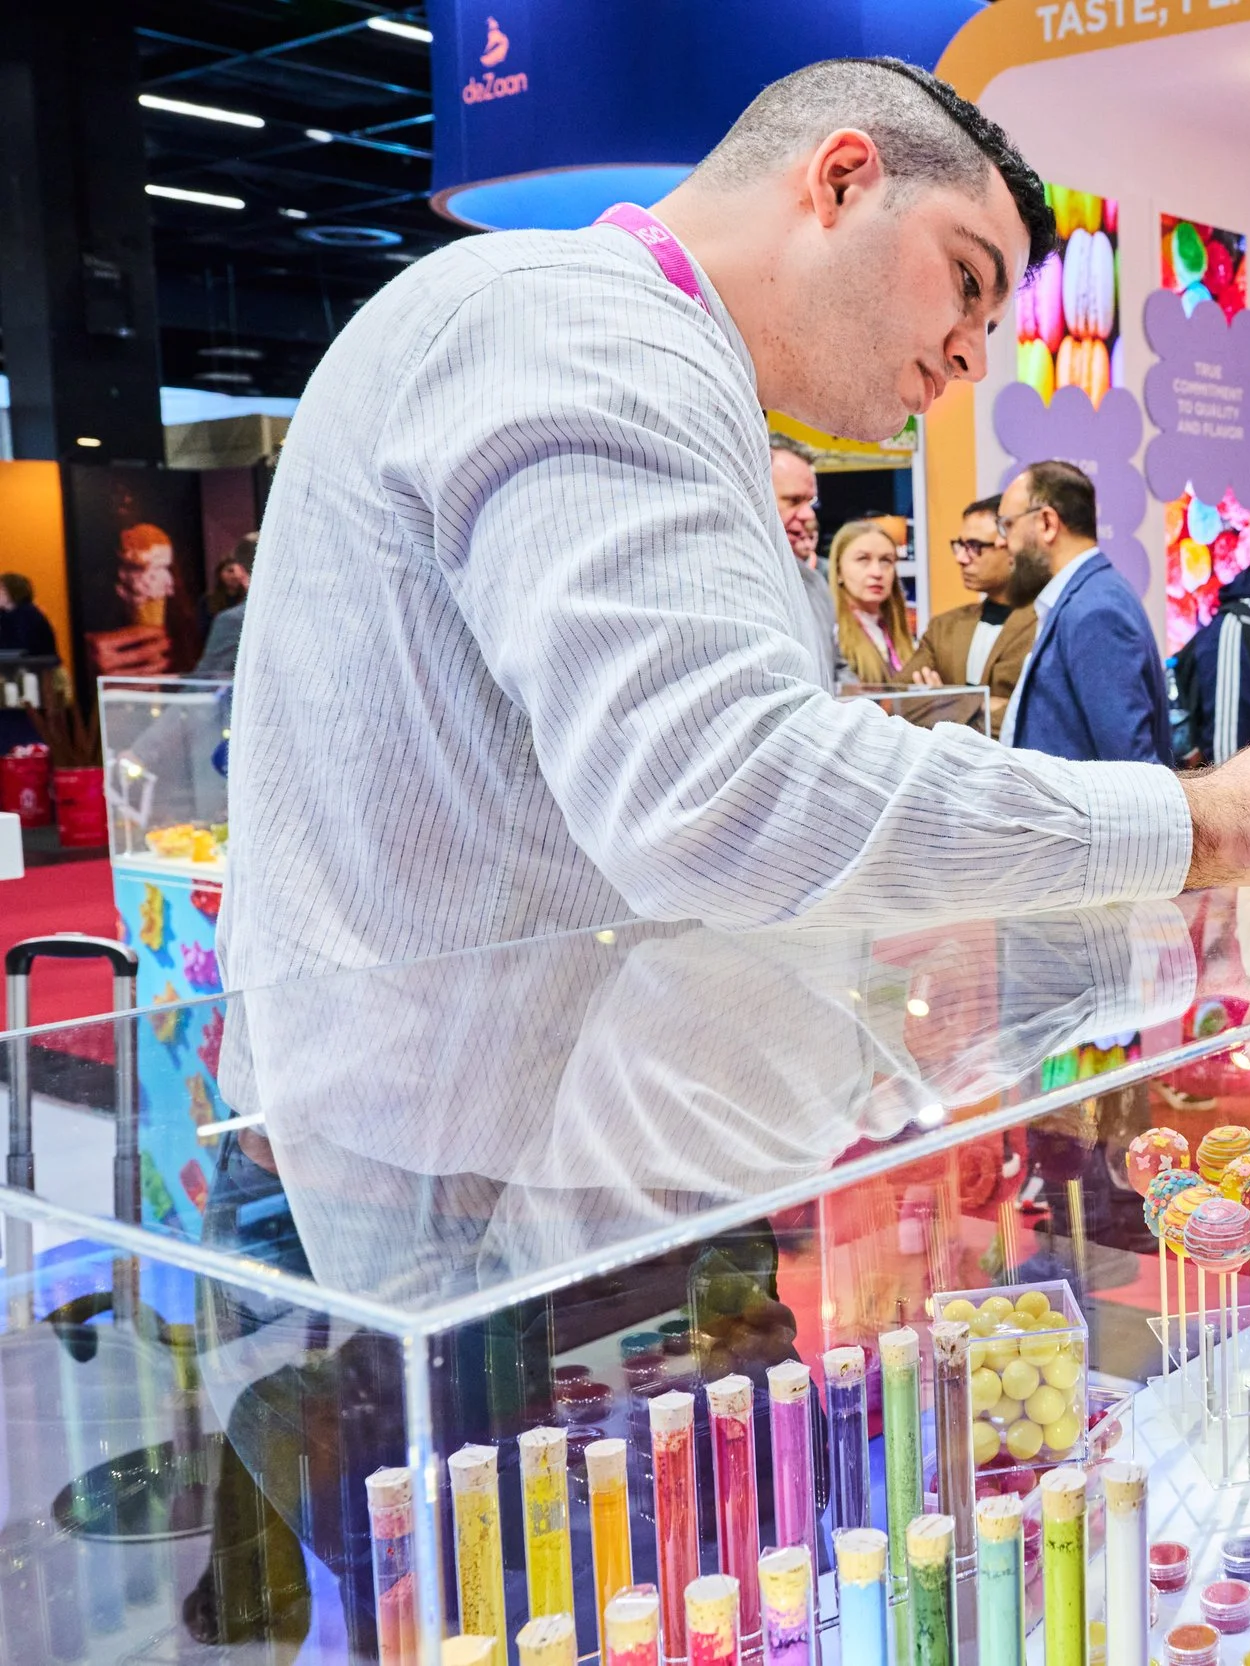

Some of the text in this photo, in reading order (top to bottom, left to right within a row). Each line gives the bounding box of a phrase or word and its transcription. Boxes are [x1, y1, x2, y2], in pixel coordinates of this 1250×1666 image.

[1036, 0, 1168, 42] TASTE,
[462, 72, 528, 105] deZaan
[1194, 361, 1222, 380] TRUE
[1173, 378, 1244, 402] COMMITMENT
[1178, 399, 1239, 420] TO QUALITY
[1177, 419, 1244, 440] AND FLAVOR
